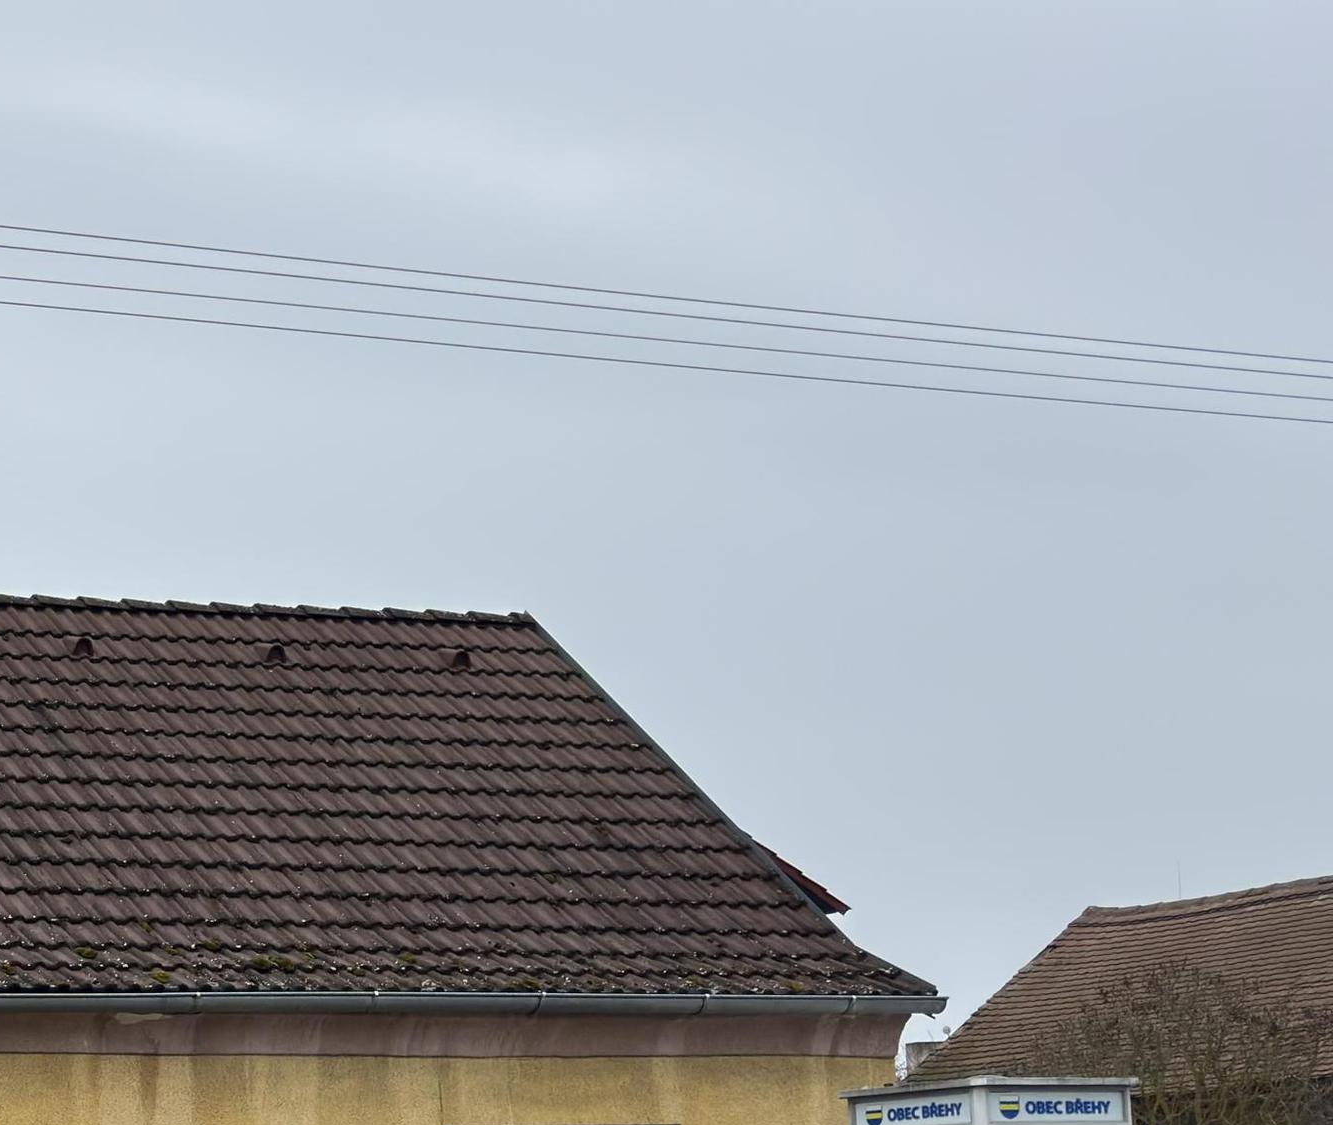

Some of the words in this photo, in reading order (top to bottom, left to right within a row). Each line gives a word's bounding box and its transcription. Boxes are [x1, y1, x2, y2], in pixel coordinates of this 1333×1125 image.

[887, 1106, 921, 1122] OBEC
[921, 1102, 963, 1119] BŘEHY
[1025, 1101, 1063, 1115] OBEC
[1065, 1098, 1111, 1115] BŘEHY
